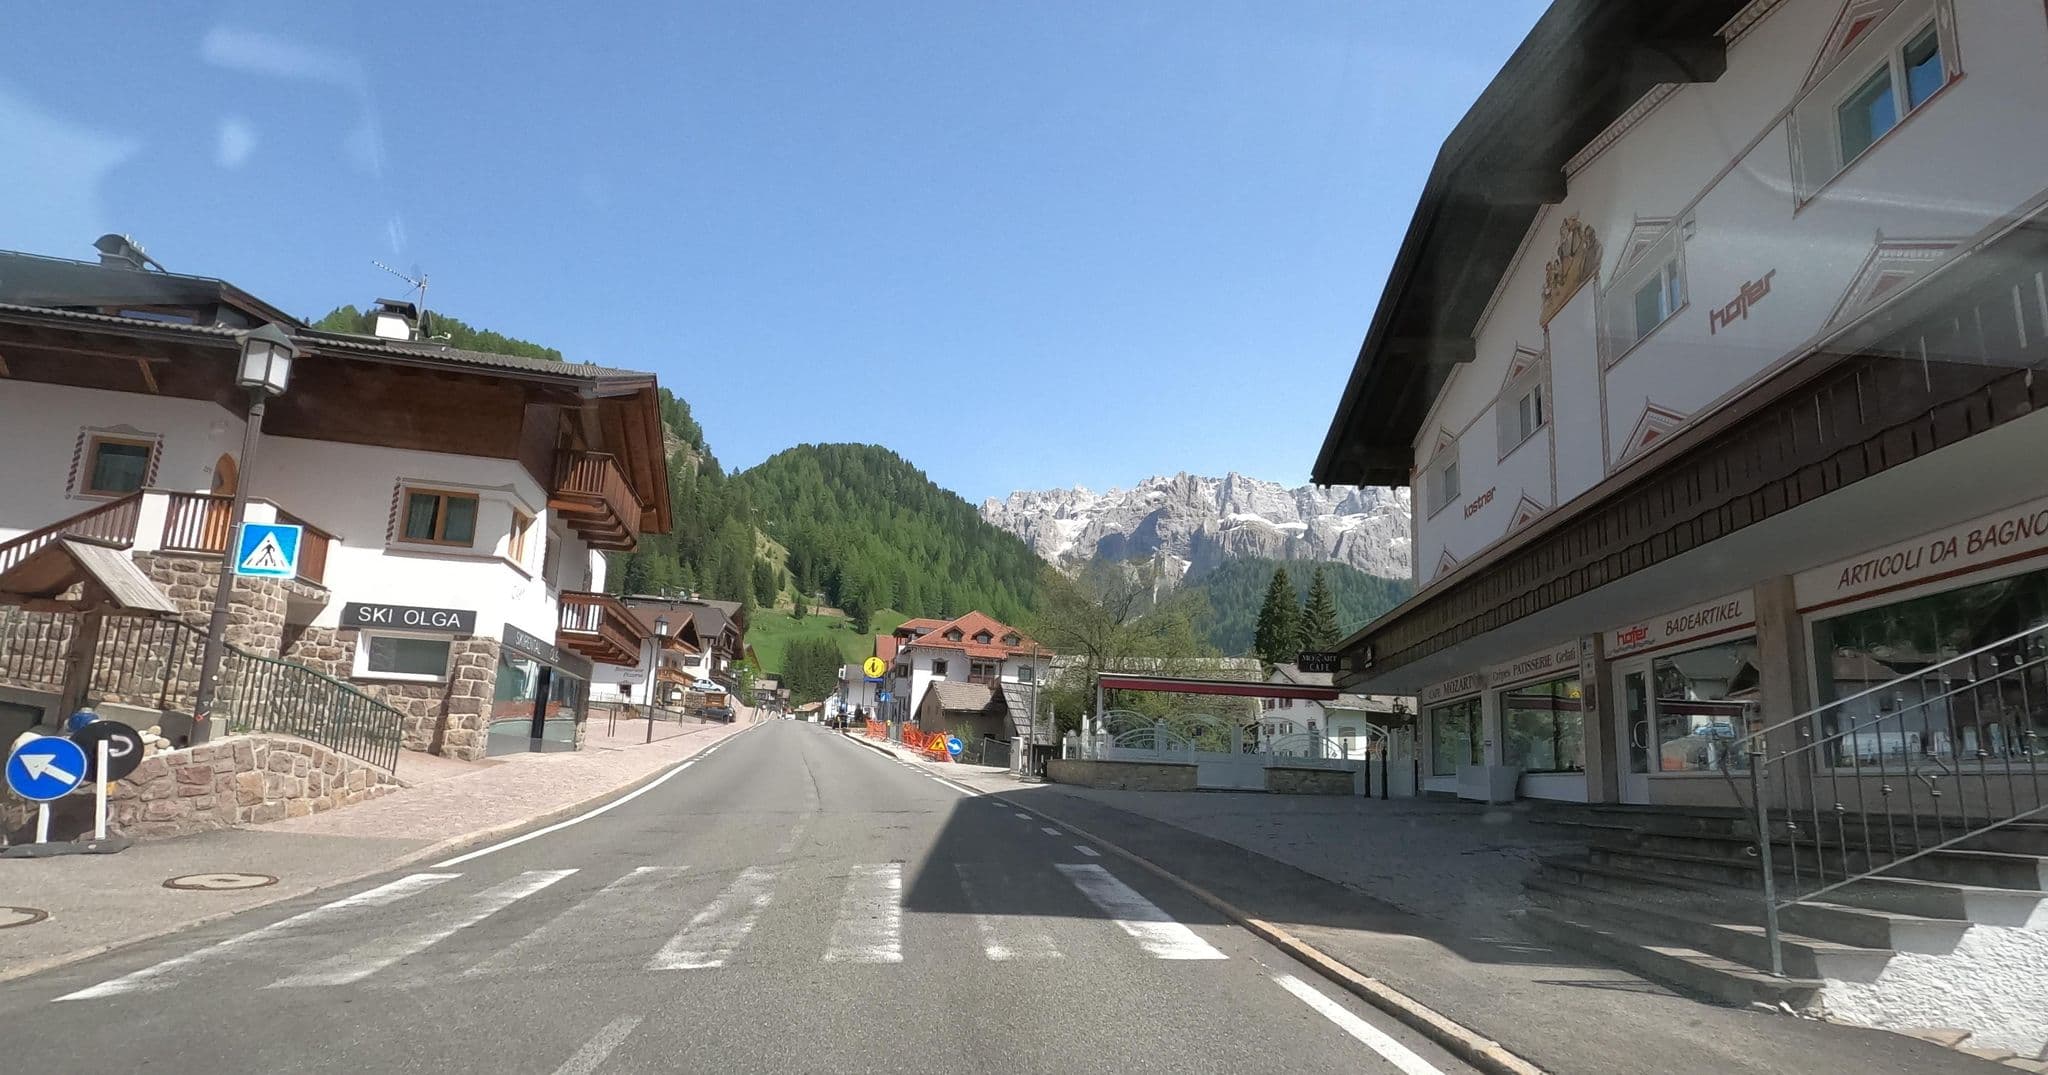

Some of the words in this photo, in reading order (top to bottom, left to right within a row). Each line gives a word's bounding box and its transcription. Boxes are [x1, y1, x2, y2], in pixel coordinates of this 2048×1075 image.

[1710, 268, 1776, 336] hofer
[1837, 546, 1923, 589] ARTICOLI
[1929, 535, 1958, 564] DA
[1967, 509, 2048, 555] BAGNO
[358, 606, 393, 623] SKI
[403, 609, 461, 628] OLGA
[1616, 626, 1649, 648] hofer
[1665, 600, 1743, 636] BADEARTIKEL
[1512, 654, 1553, 677] PATISSERIE
[1443, 675, 1473, 697] MOZART
